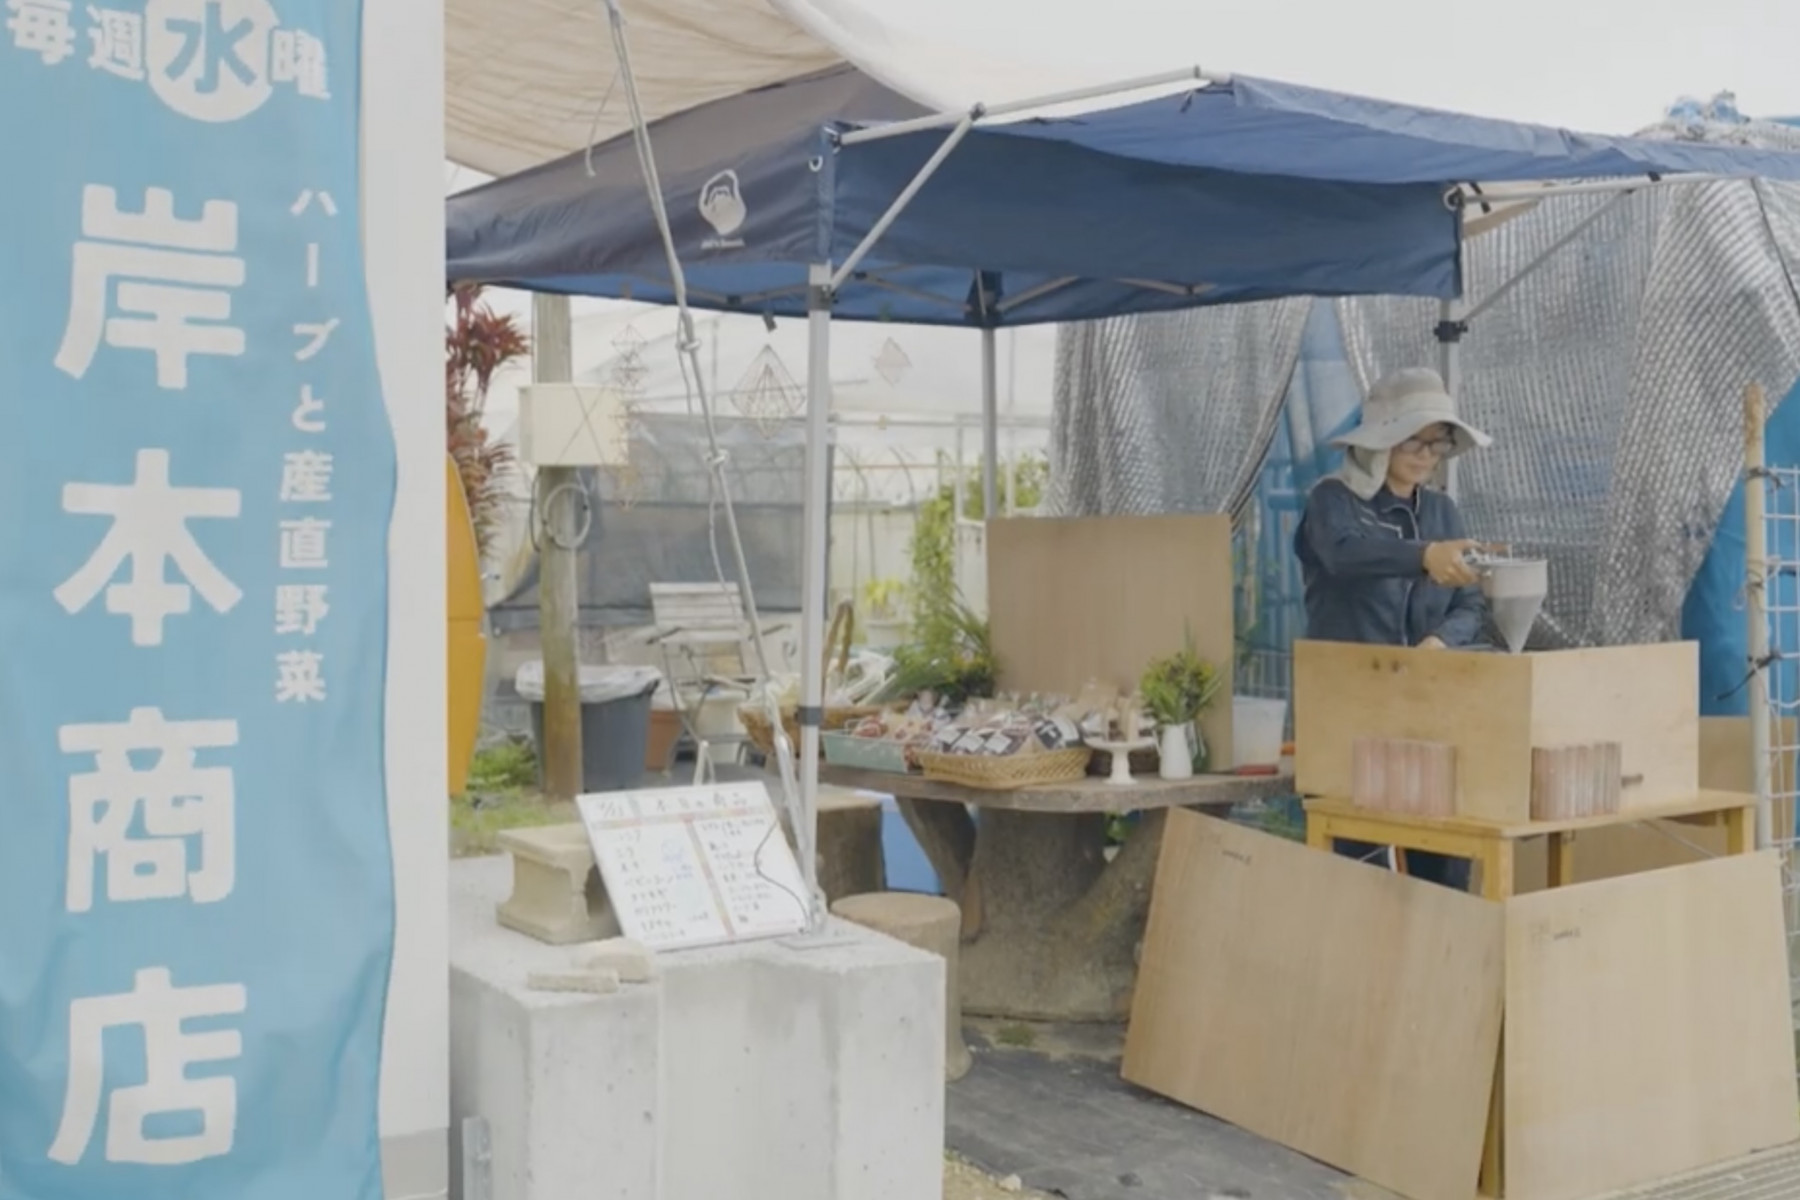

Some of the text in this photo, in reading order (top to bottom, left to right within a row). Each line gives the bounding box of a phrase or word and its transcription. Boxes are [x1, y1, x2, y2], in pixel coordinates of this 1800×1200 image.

[47, 183, 248, 1165] 岸本商店
[273, 188, 340, 704] ハーブと産直野菜
